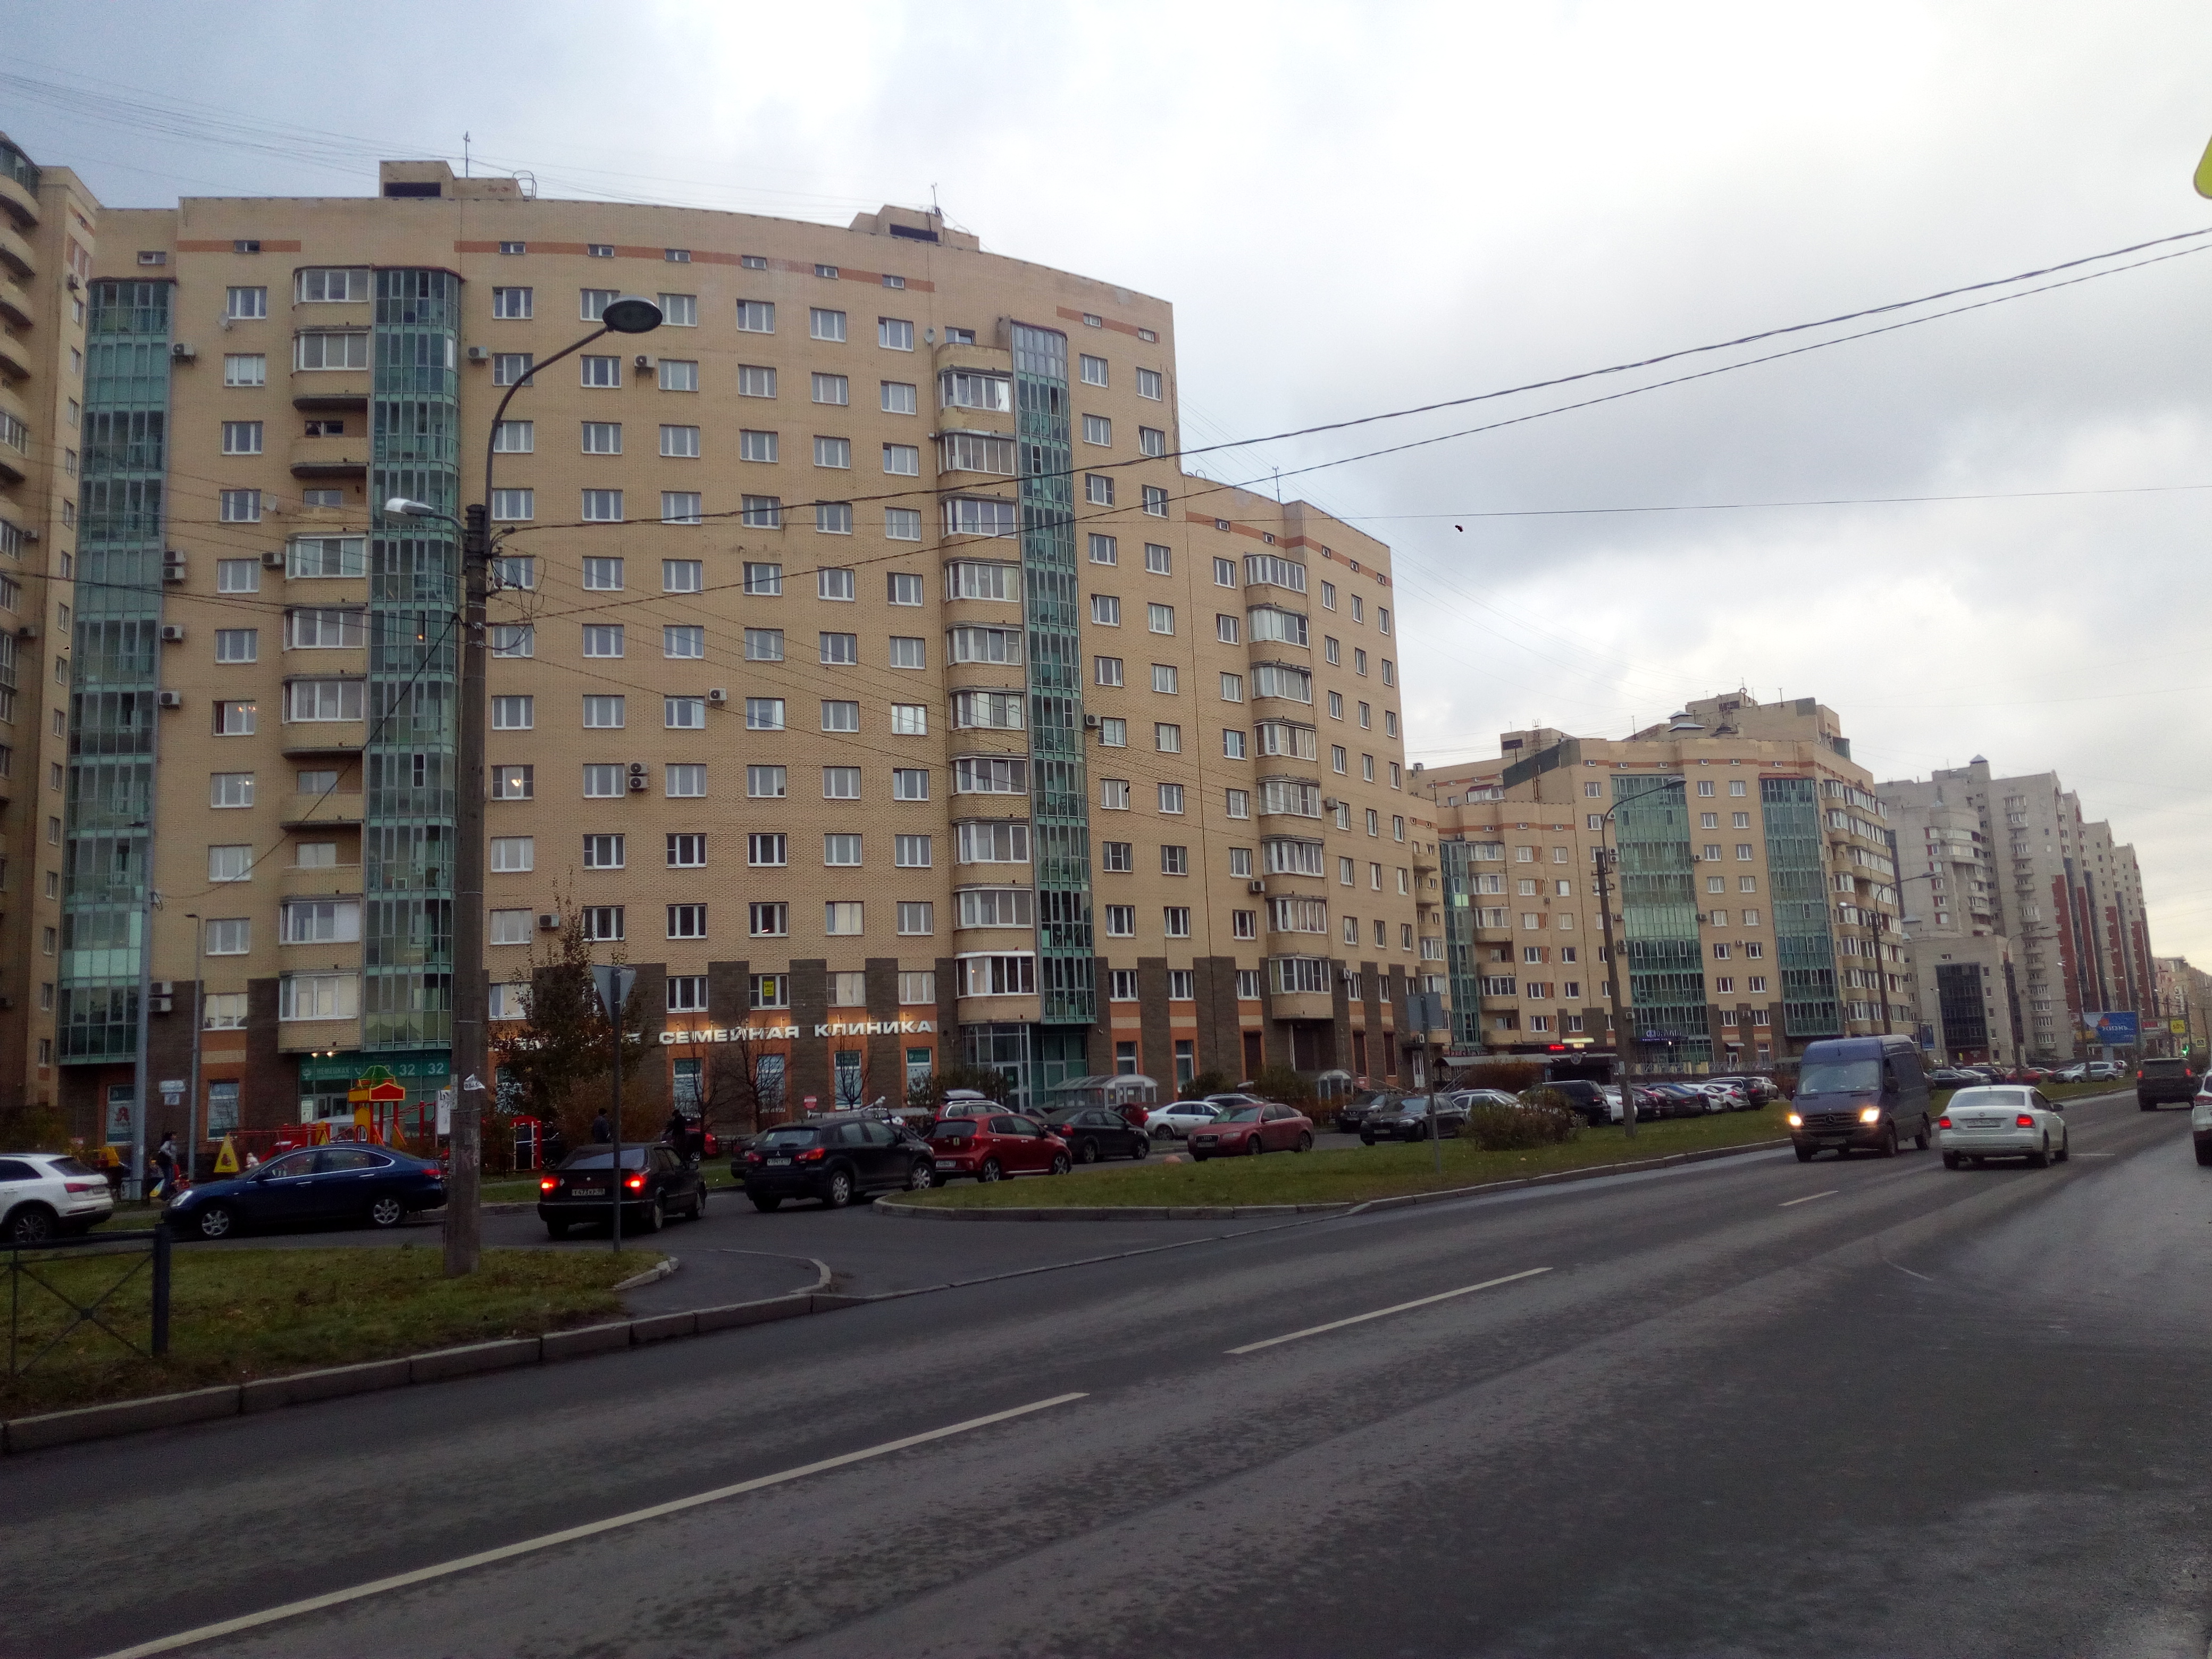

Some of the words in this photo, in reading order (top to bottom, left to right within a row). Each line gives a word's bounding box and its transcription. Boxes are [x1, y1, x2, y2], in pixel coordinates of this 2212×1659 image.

[658, 1025, 799, 1045] СЕМЕЙНАЯ
[814, 1020, 933, 1037] КЛИНИКА
[399, 1063, 415, 1076] 32
[428, 1063, 445, 1075] 32
